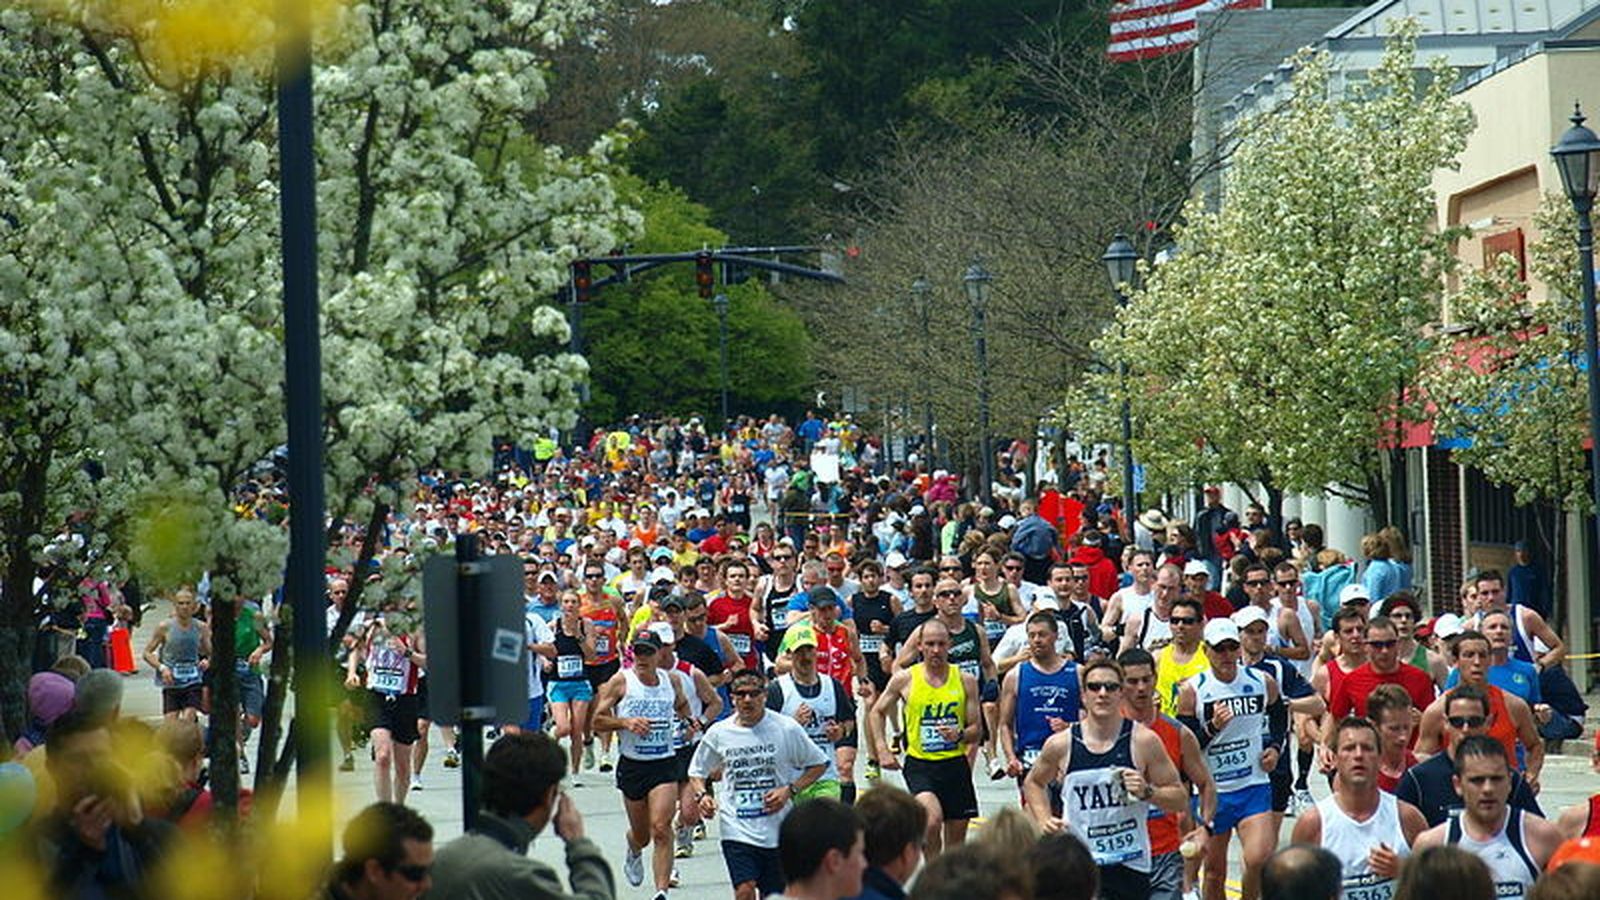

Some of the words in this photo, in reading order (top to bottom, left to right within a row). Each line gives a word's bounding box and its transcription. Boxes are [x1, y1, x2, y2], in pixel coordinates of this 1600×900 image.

[726, 744, 776, 756] RUNNING
[728, 758, 750, 769] FOR
[754, 757, 777, 766] THE
[1073, 782, 1128, 810] YAL
[1096, 834, 1134, 853] 5159
